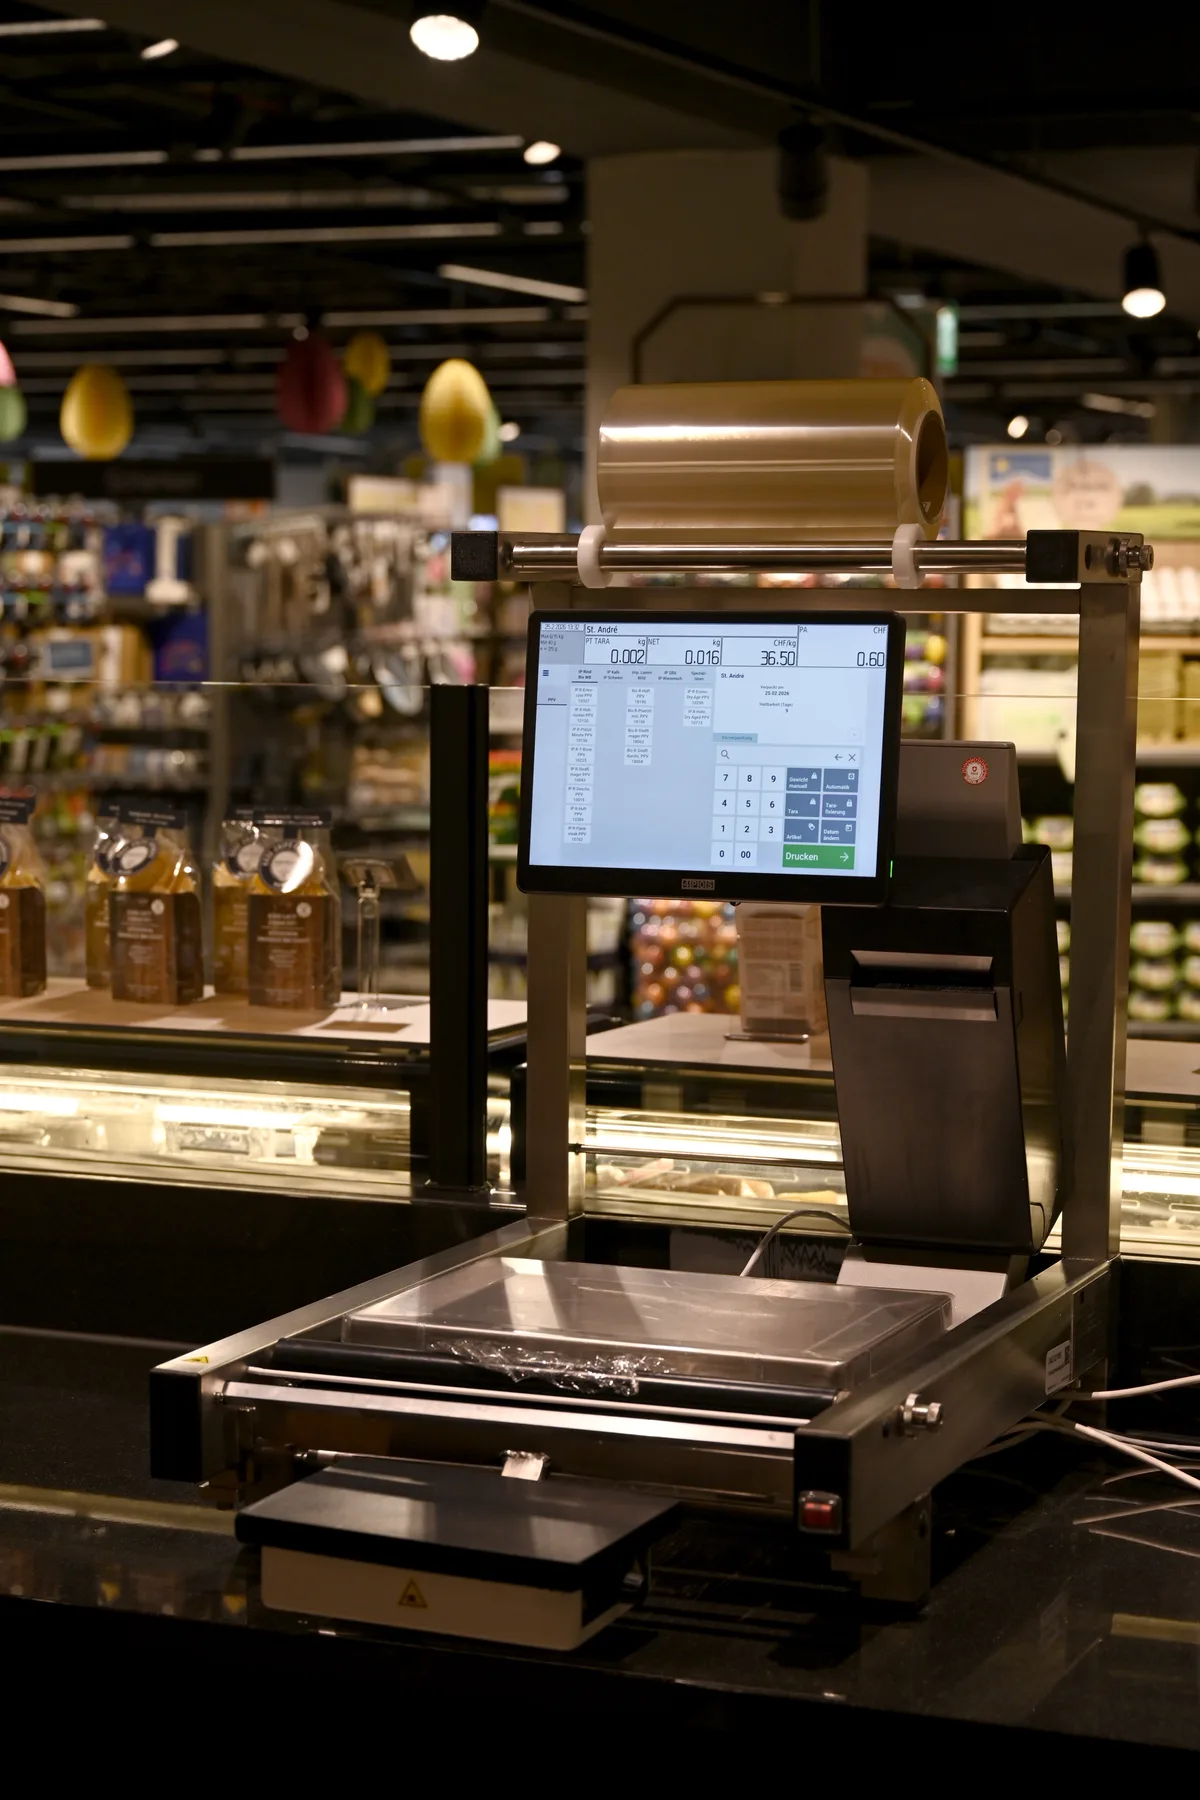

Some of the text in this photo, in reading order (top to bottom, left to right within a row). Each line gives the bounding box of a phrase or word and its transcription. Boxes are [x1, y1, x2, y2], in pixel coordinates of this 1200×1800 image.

[597, 625, 618, 634] André
[774, 640, 796, 648] CHF/kg
[611, 649, 644, 664] 0.002
[685, 650, 720, 664] 0.016
[760, 650, 795, 666] 36.50
[857, 652, 885, 666] 0.60
[786, 852, 818, 861] Drucken
